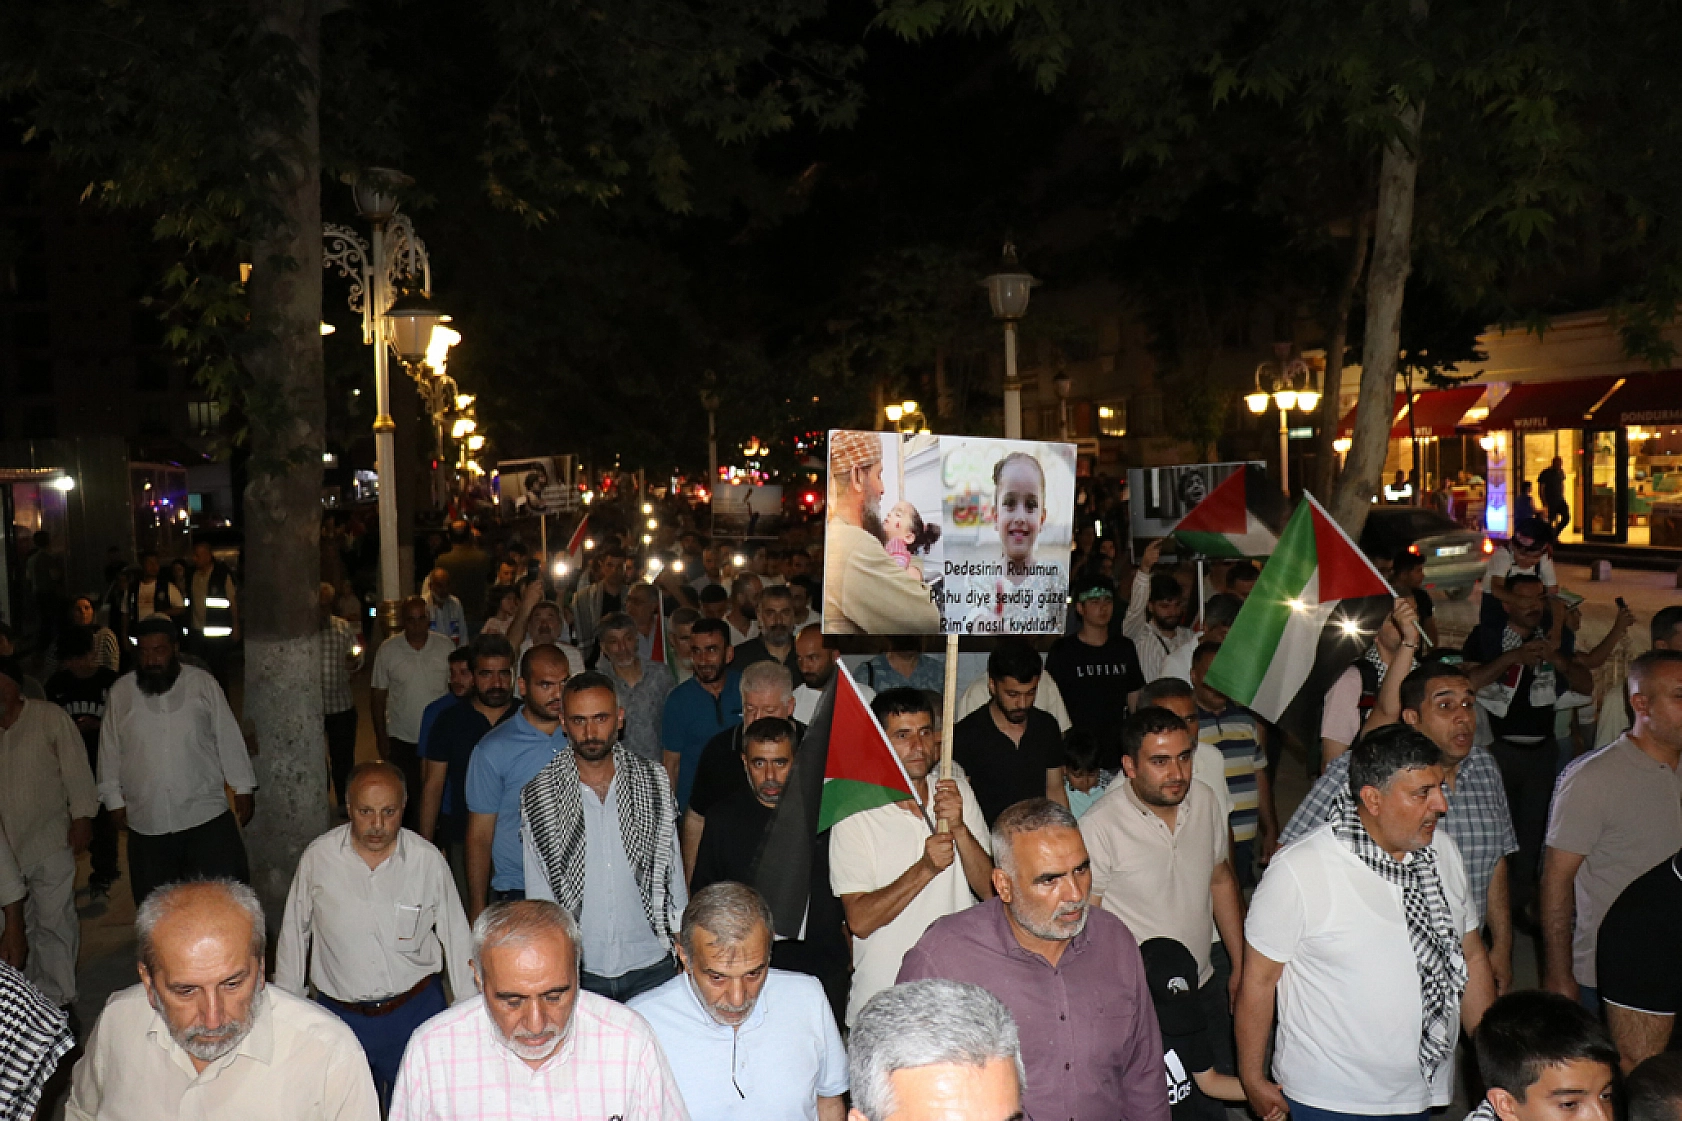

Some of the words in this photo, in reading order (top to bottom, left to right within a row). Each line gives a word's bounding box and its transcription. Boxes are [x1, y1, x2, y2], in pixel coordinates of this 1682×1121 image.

[945, 560, 1003, 576] Dedesinin
[1007, 560, 1059, 576] Ruhumun
[966, 589, 990, 608] diye
[996, 589, 1034, 608] sevdiği
[1038, 589, 1068, 609] güzel
